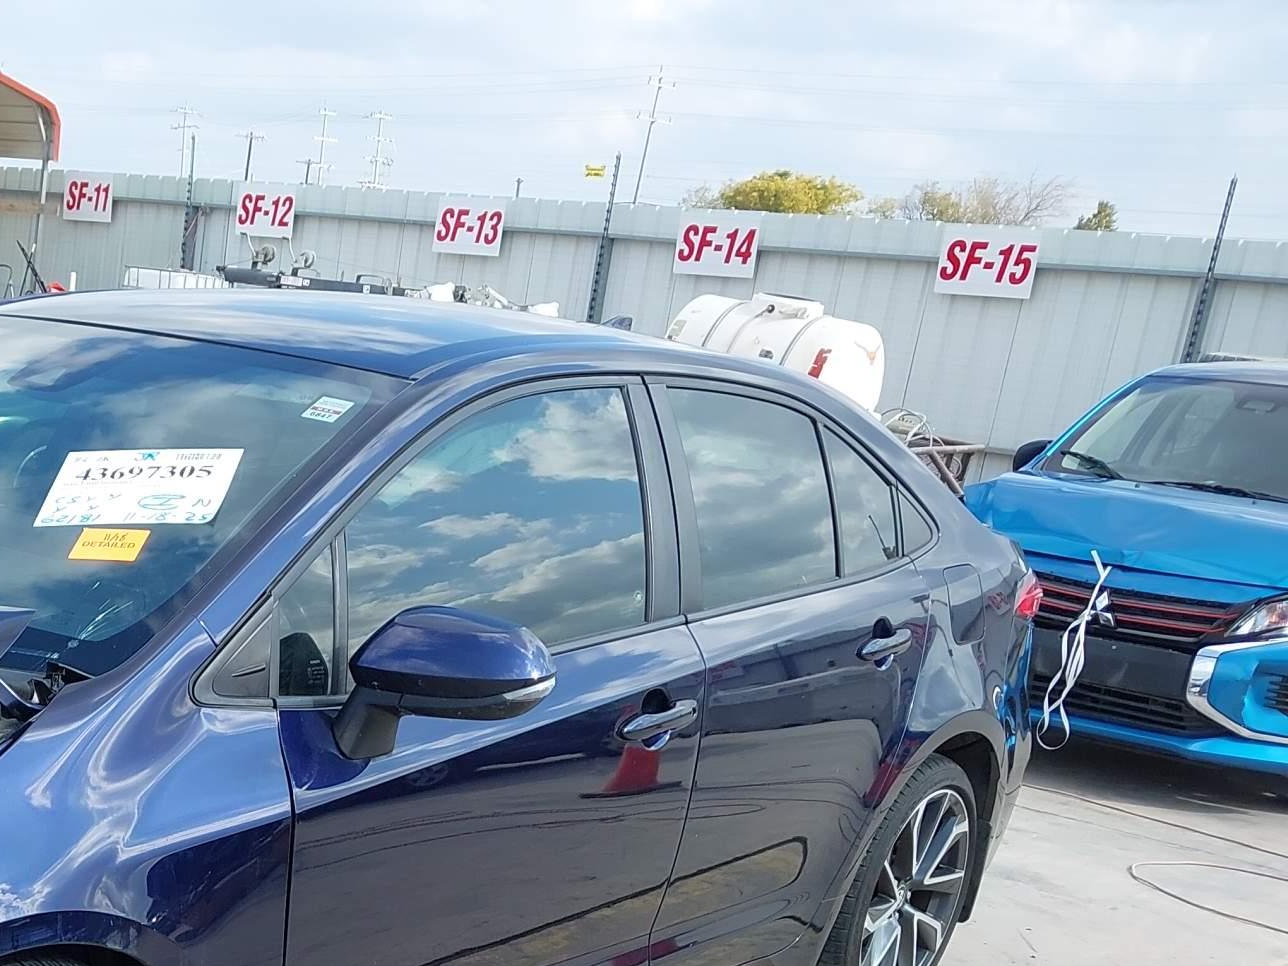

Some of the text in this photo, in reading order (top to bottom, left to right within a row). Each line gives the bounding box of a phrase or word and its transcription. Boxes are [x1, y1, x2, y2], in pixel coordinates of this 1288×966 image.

[66, 180, 112, 212] SF-11
[238, 192, 294, 227] SF-12
[436, 207, 503, 246] SF-13
[678, 223, 757, 266] SF-14
[939, 239, 1037, 286] SF-15
[75, 465, 214, 480] 43697305
